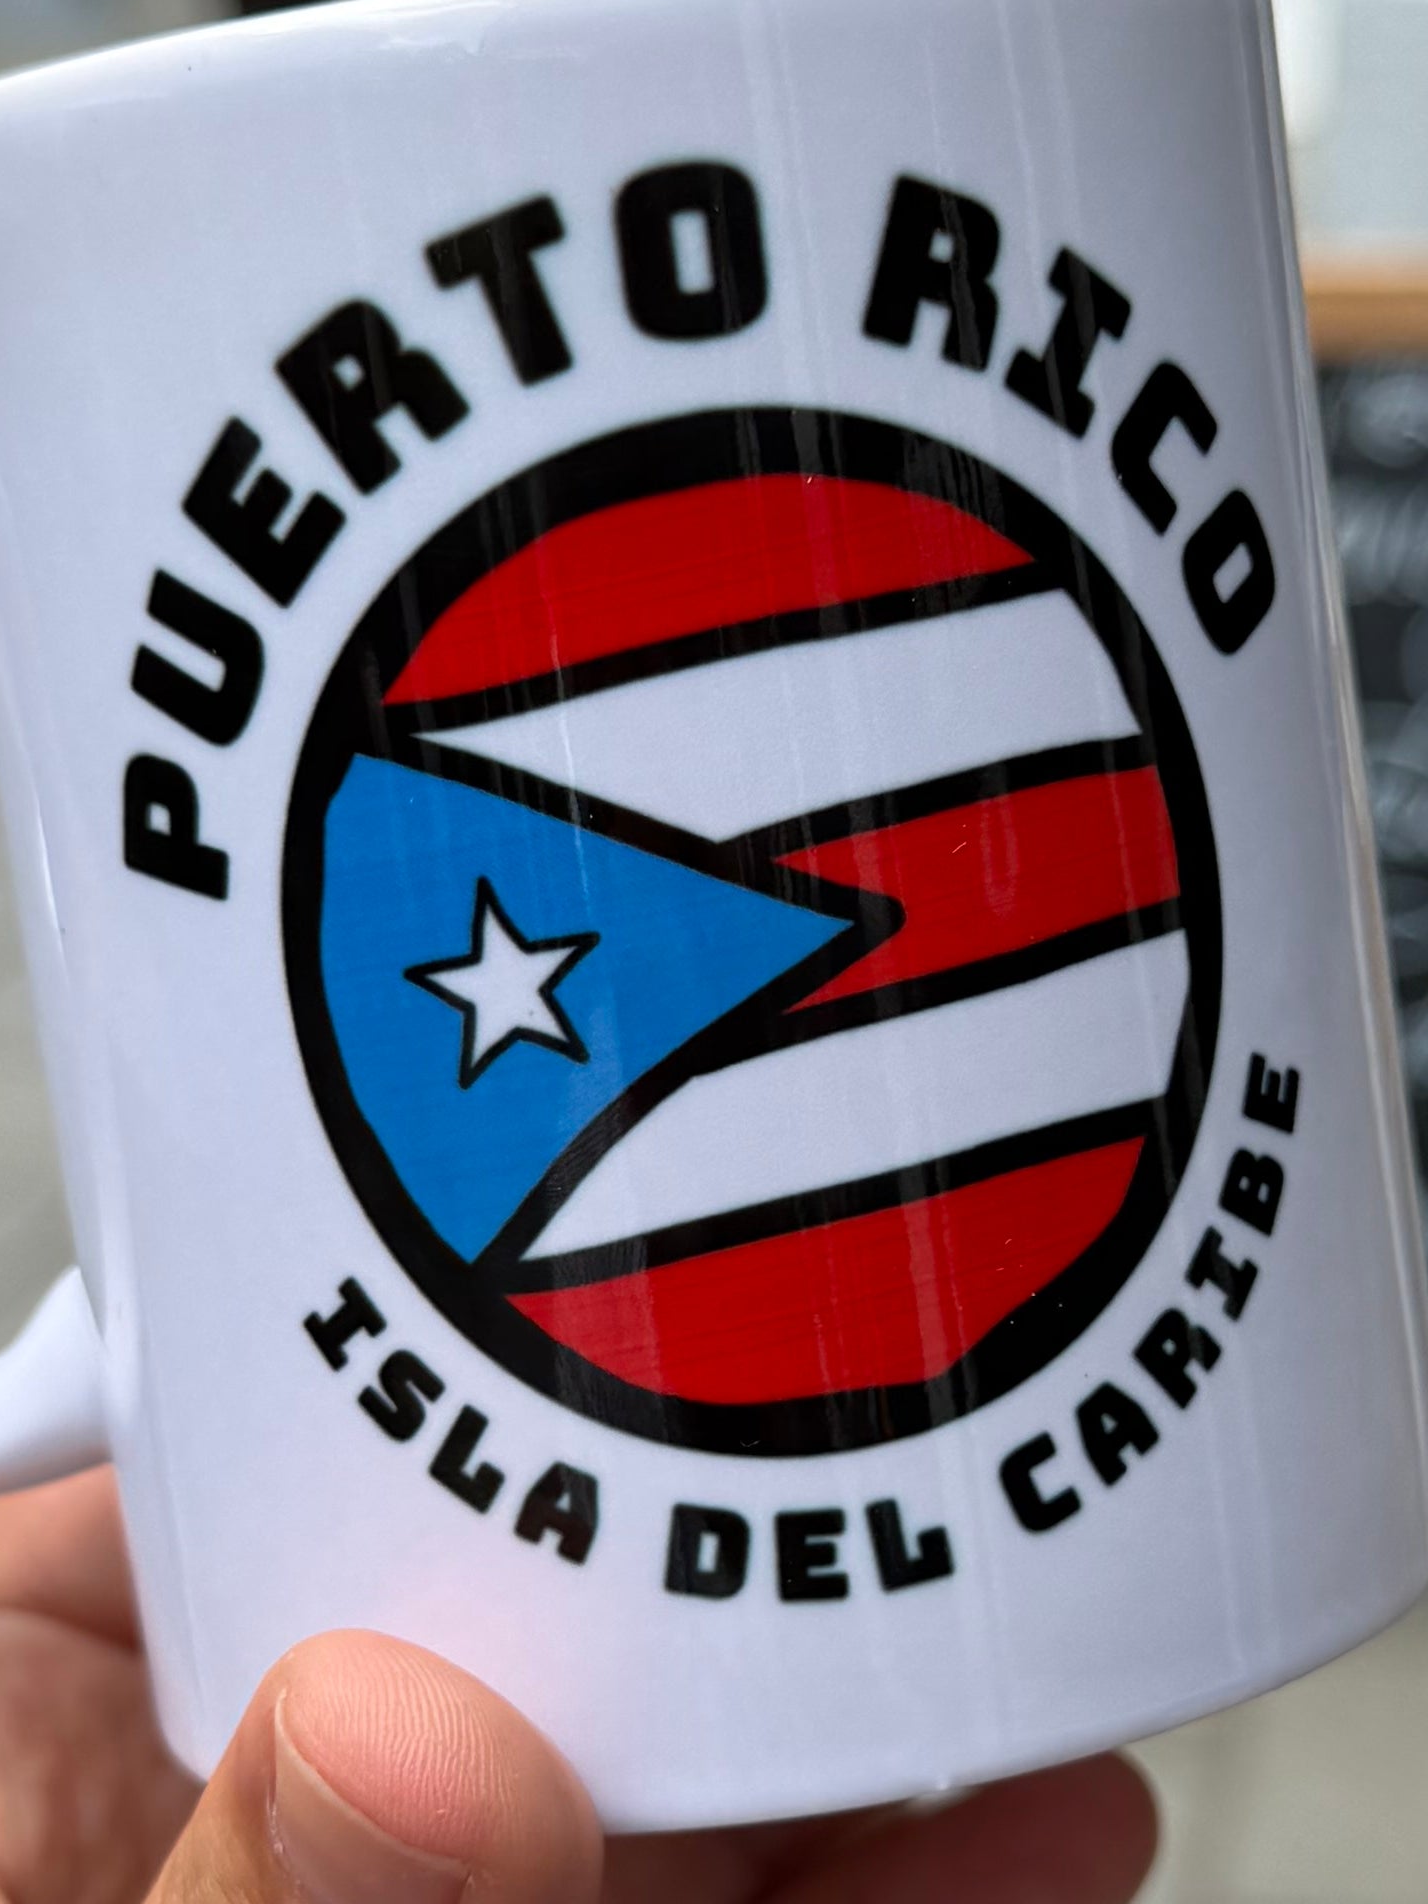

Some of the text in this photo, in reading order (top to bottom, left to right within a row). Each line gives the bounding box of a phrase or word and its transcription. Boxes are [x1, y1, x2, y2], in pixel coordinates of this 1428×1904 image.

[121, 158, 1279, 903] PUERTO RICO
[301, 1050, 1303, 1605] ISLA DEL CARIBE
